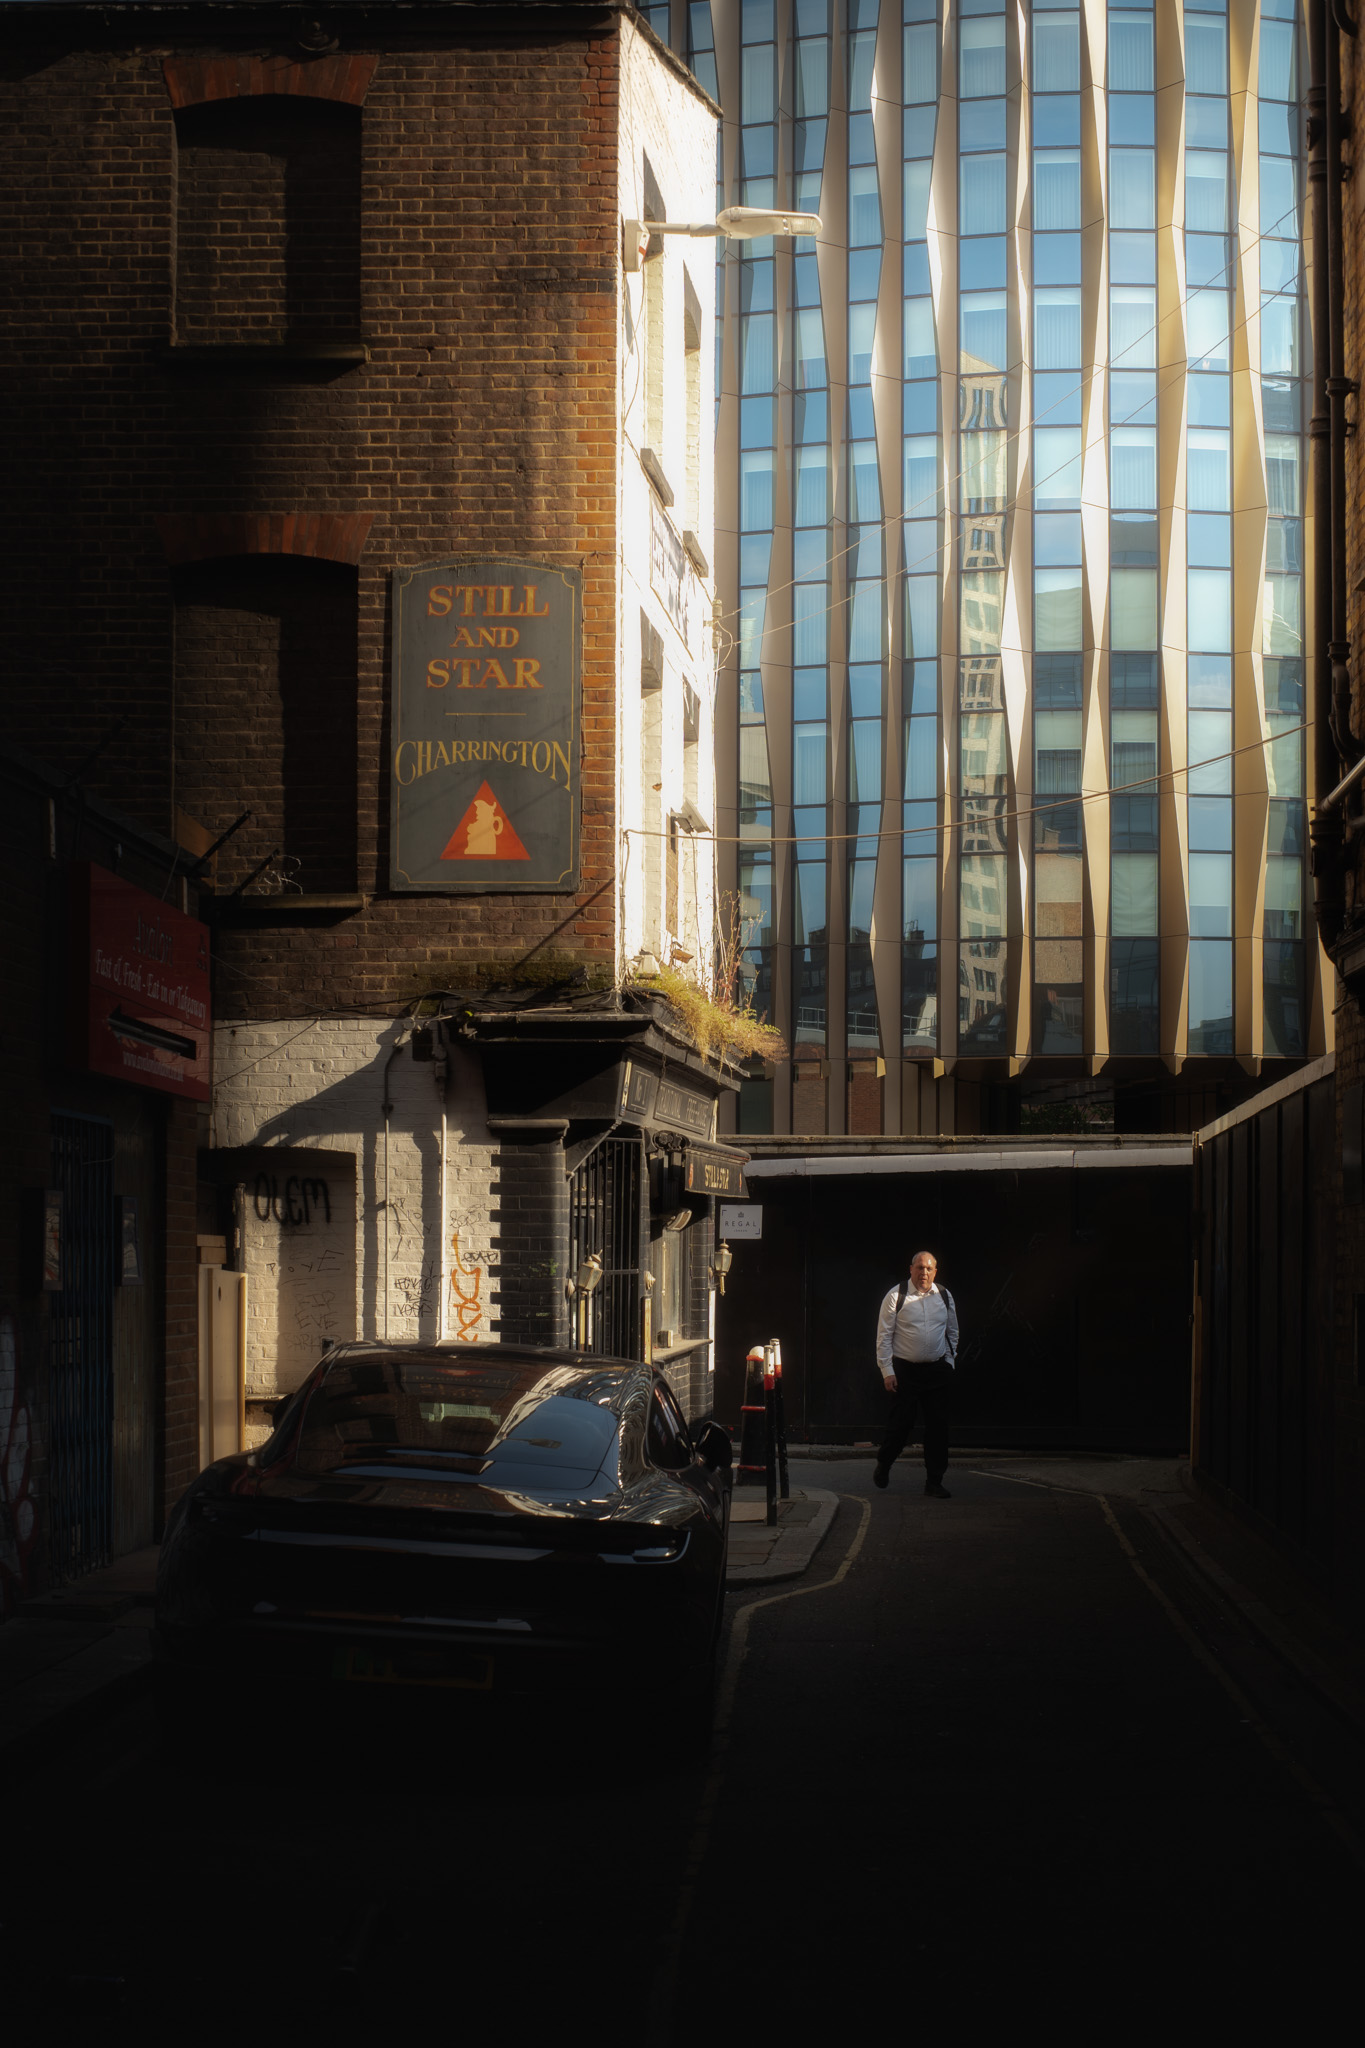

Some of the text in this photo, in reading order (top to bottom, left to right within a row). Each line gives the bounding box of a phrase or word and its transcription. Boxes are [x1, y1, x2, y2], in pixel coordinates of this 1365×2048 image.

[427, 585, 550, 617] STILL
[450, 626, 520, 649] AND
[426, 658, 544, 689] STAR
[394, 740, 572, 793] CHARRINGTON
[95, 949, 112, 979] Fast
[123, 961, 143, 992] Fresh
[146, 973, 160, 1000] Eat
[160, 977, 168, 1004] in
[169, 988, 176, 1006] or
[176, 985, 207, 1027] Takeaway
